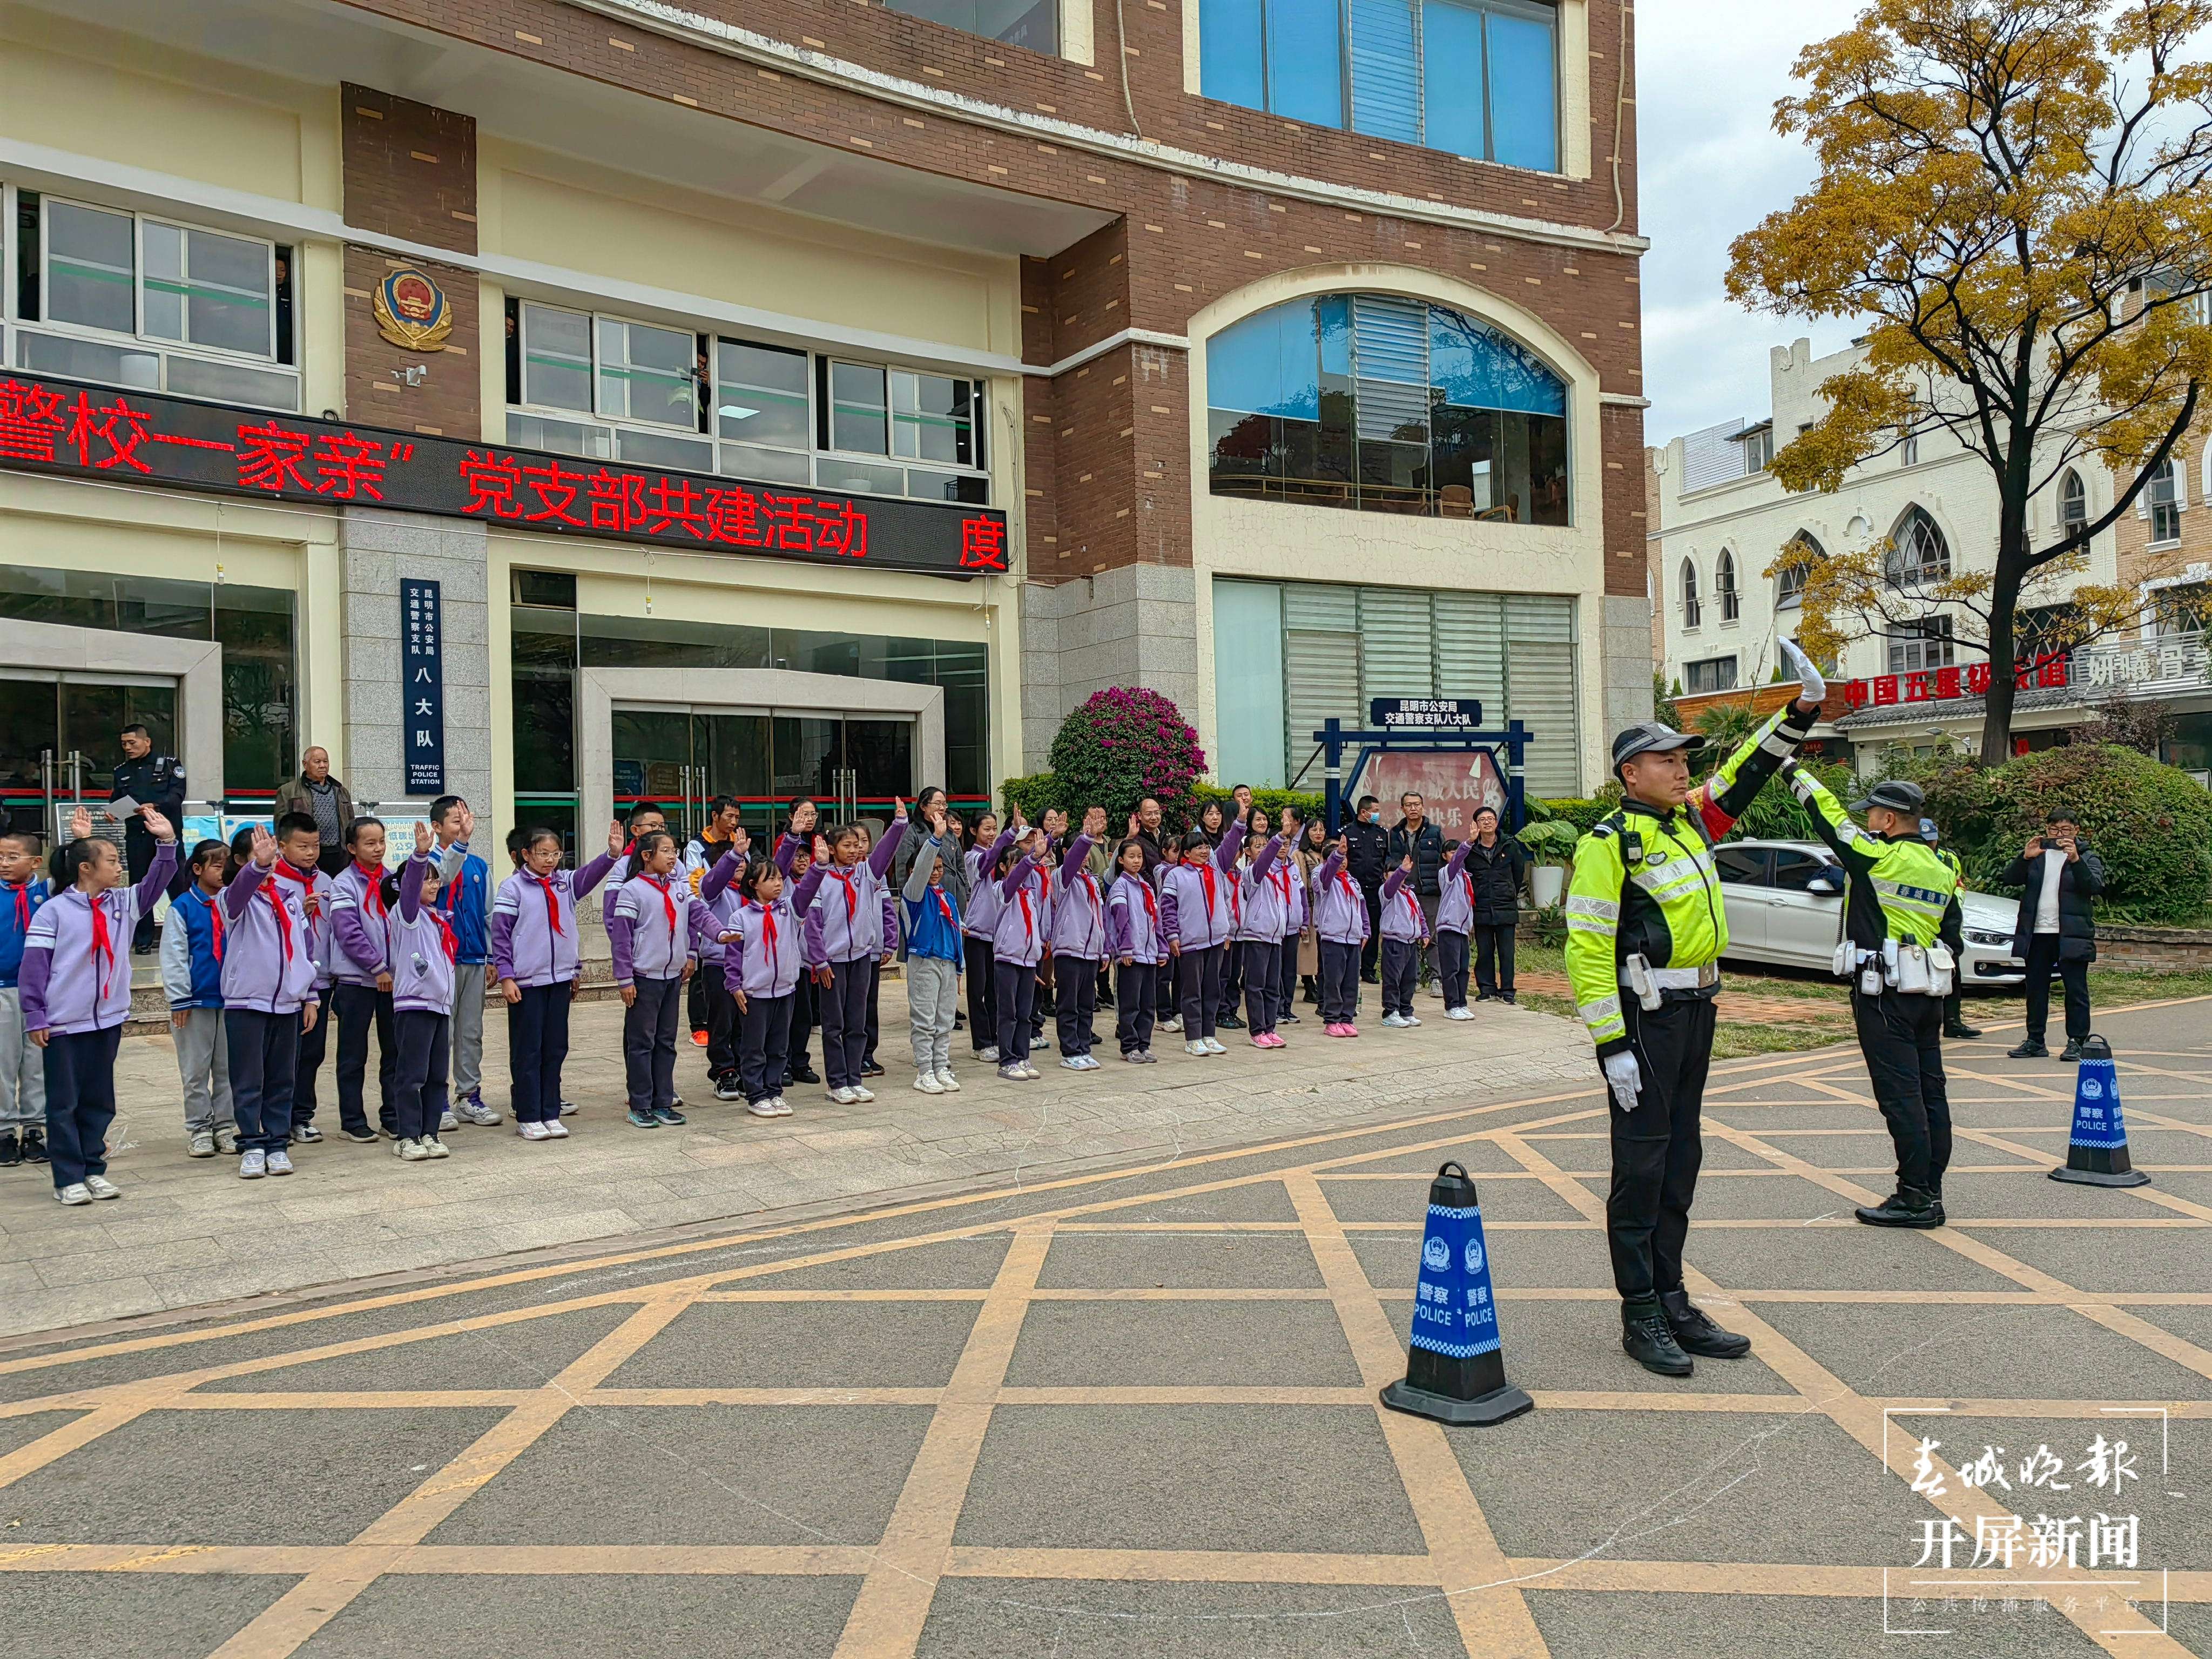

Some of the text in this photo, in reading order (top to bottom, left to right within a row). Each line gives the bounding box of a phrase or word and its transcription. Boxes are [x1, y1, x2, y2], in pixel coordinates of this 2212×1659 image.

[460, 449, 867, 557] 党支部共建活动
[960, 514, 1006, 569] 度
[410, 588, 421, 655] 交通警察支队
[424, 589, 434, 656] 昆明市公安局
[415, 667, 434, 747] 八大队
[1400, 700, 1457, 712] 昆明市公安局
[1385, 712, 1472, 725] 交通警察支队八大队
[2080, 1107, 2103, 1118] 警察
[2076, 1120, 2107, 1131] POLICE
[1419, 1282, 1449, 1305] 警察
[1467, 1286, 1488, 1307] 警察
[1414, 1303, 1452, 1326] POLICE
[1465, 1307, 1493, 1327] POLICE
